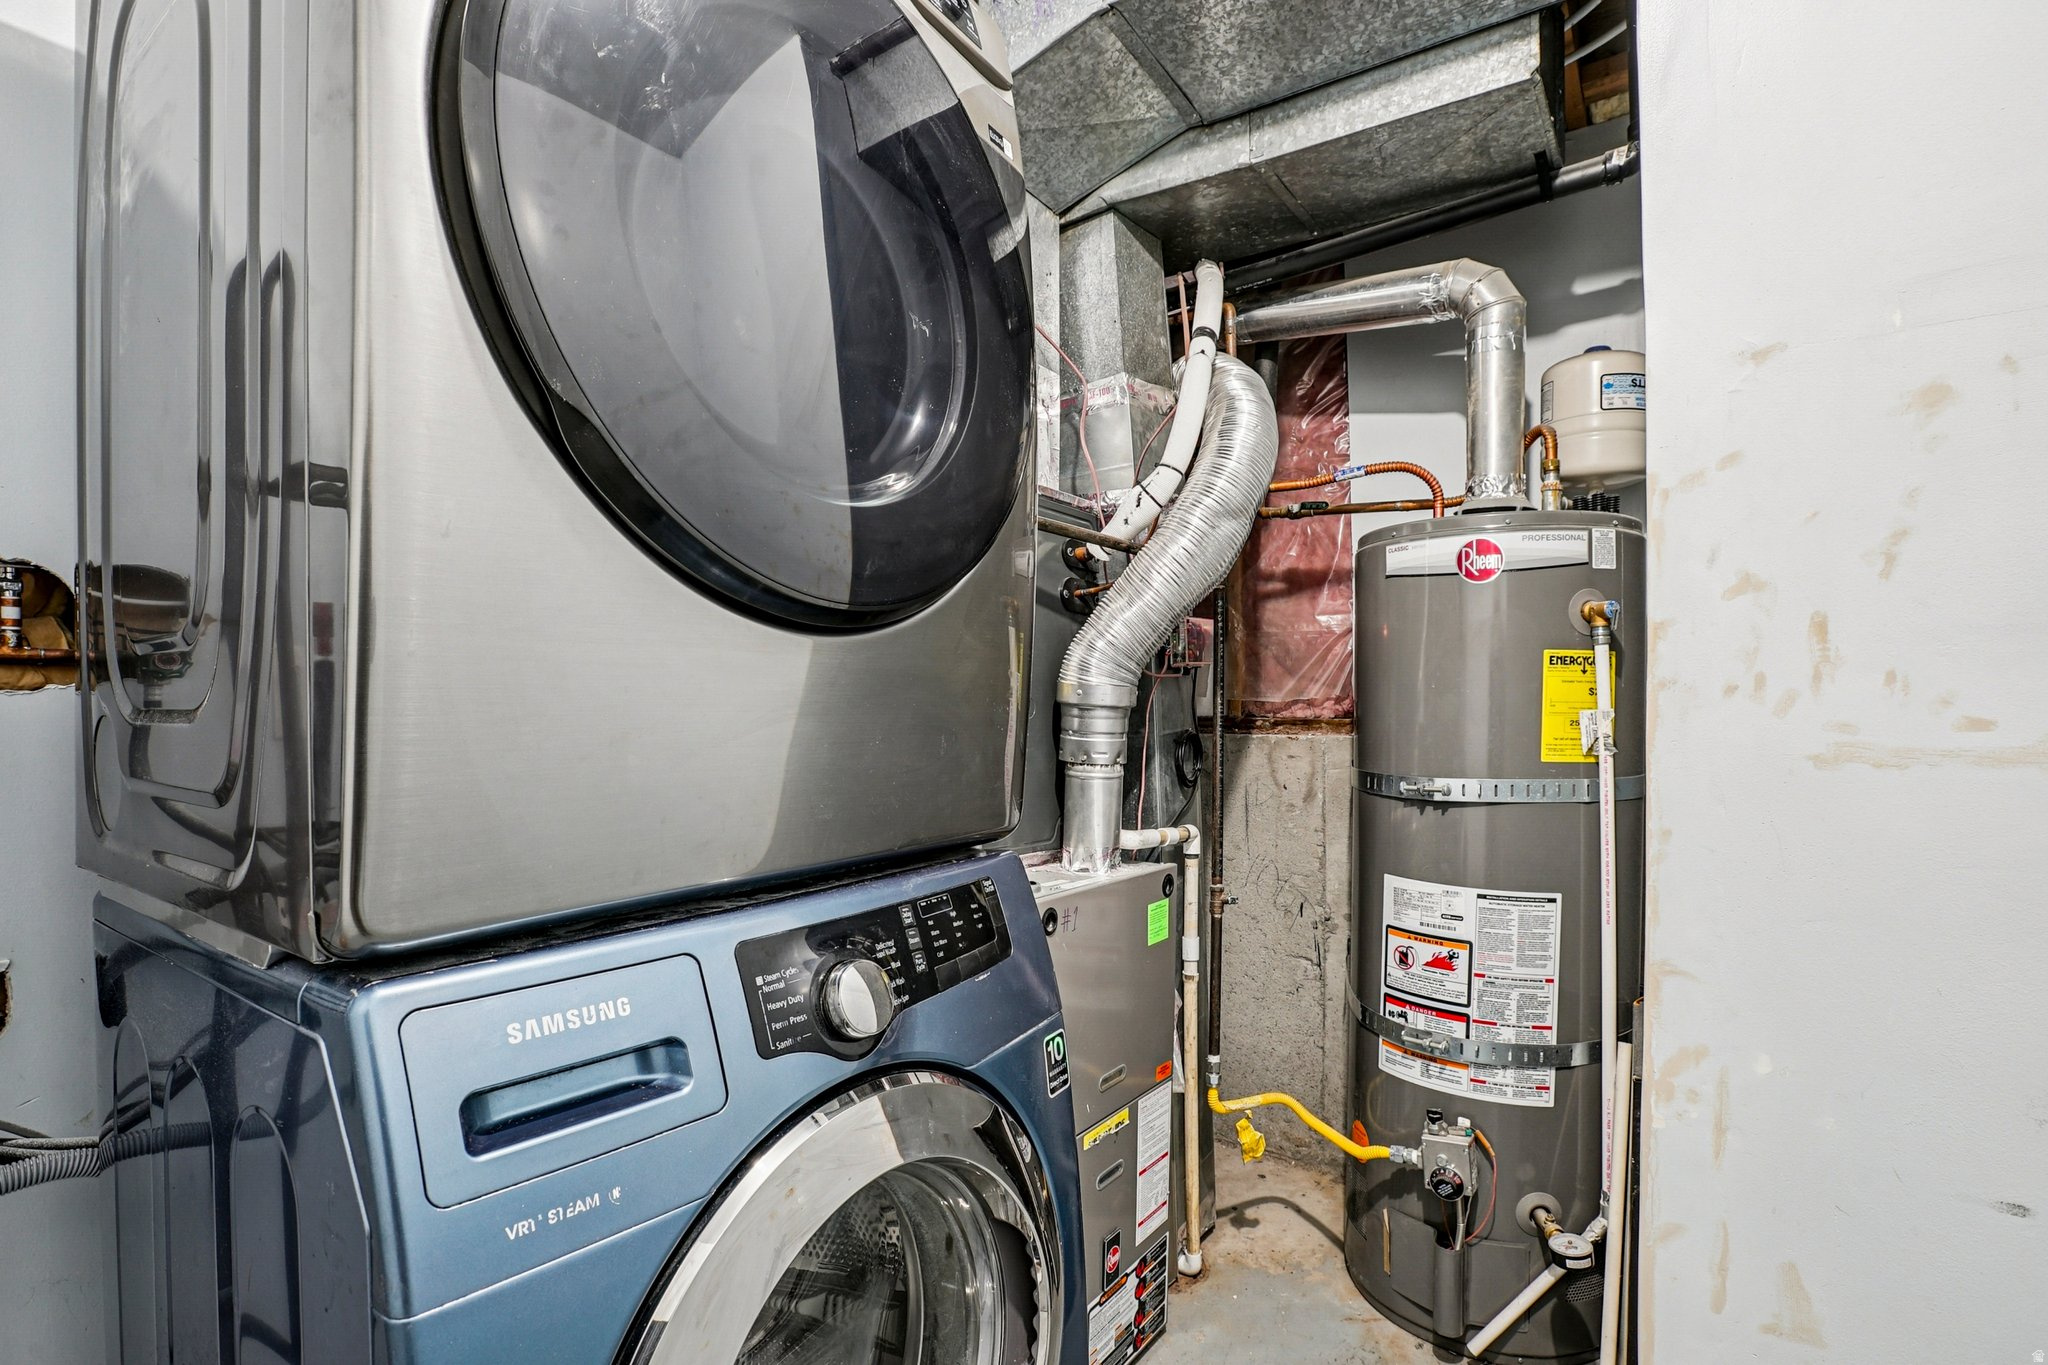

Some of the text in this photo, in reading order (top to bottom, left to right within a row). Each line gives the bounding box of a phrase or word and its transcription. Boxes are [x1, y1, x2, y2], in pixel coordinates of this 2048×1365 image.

[1521, 533, 1587, 543] PROFESSIONAL
[1387, 543, 1410, 554] CLASSIC
[1461, 539, 1502, 577] Rheem
[1061, 905, 1079, 934] #1
[1414, 935, 1444, 947] WARNING
[763, 972, 782, 983] Steam
[762, 979, 786, 994] Normal
[766, 994, 805, 1012] Heavy Duty
[1411, 1004, 1437, 1017] DANGER
[506, 996, 631, 1045] SAMSUNG
[789, 1013, 808, 1026] Press
[1047, 1035, 1065, 1065] 10
